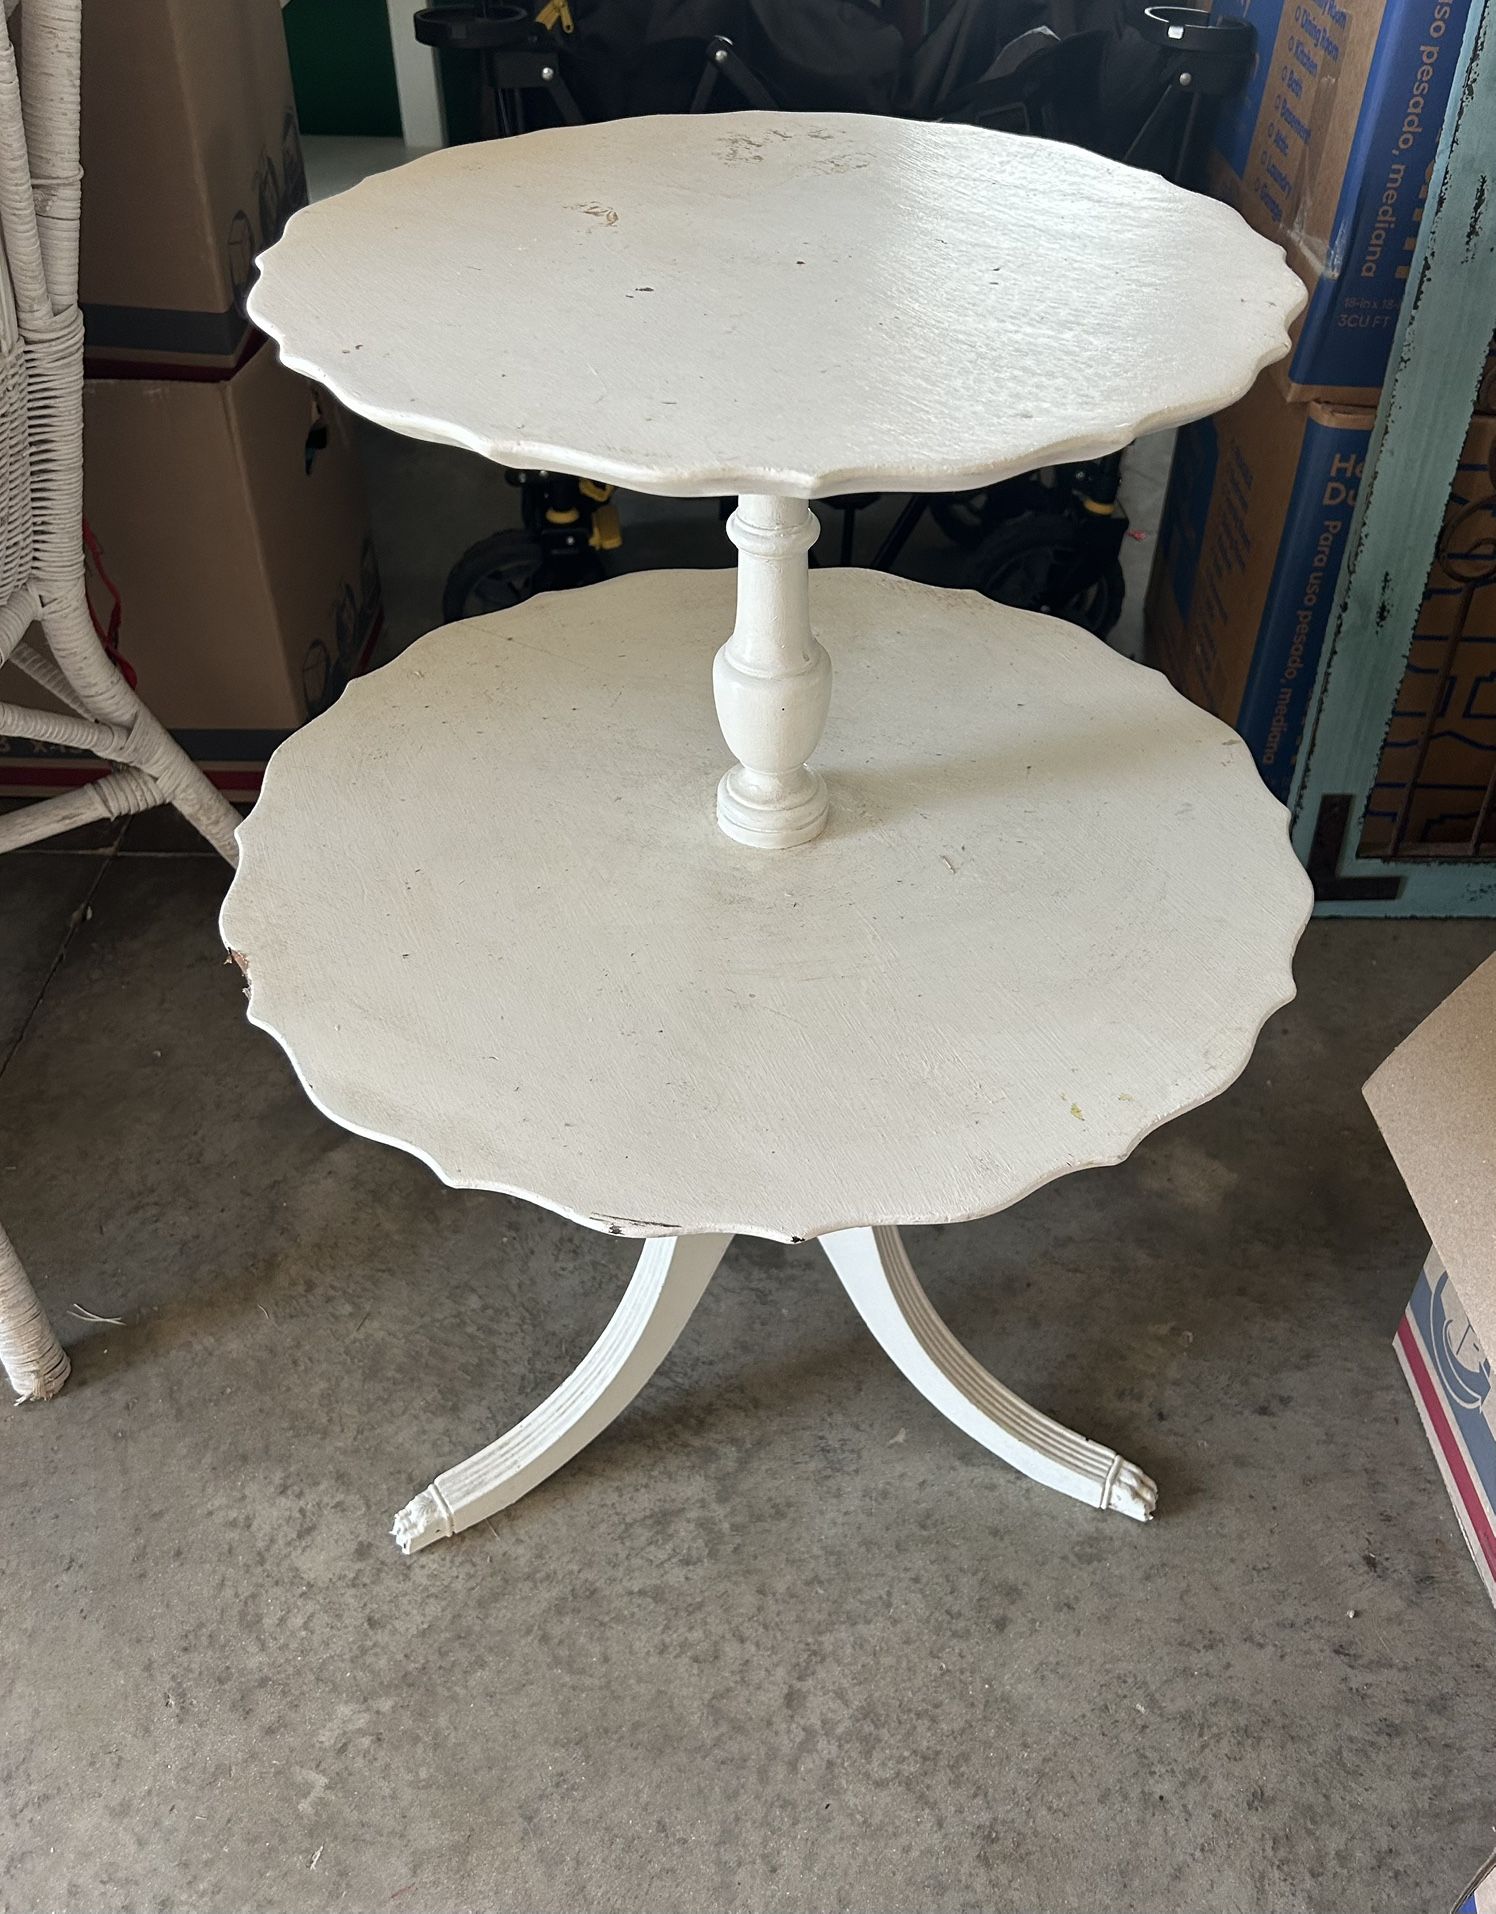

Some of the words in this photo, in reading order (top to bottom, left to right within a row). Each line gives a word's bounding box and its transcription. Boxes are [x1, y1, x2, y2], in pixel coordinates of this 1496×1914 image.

[1294, 39, 1318, 78] Kitchen
[1280, 97, 1312, 144] Basement
[1392, 45, 1440, 154] pesado,
[1361, 163, 1406, 279] mediana
[1312, 518, 1343, 568] Para
[1304, 571, 1328, 608] uso
[1280, 608, 1314, 684] pesado,
[1262, 687, 1293, 766] mediana
